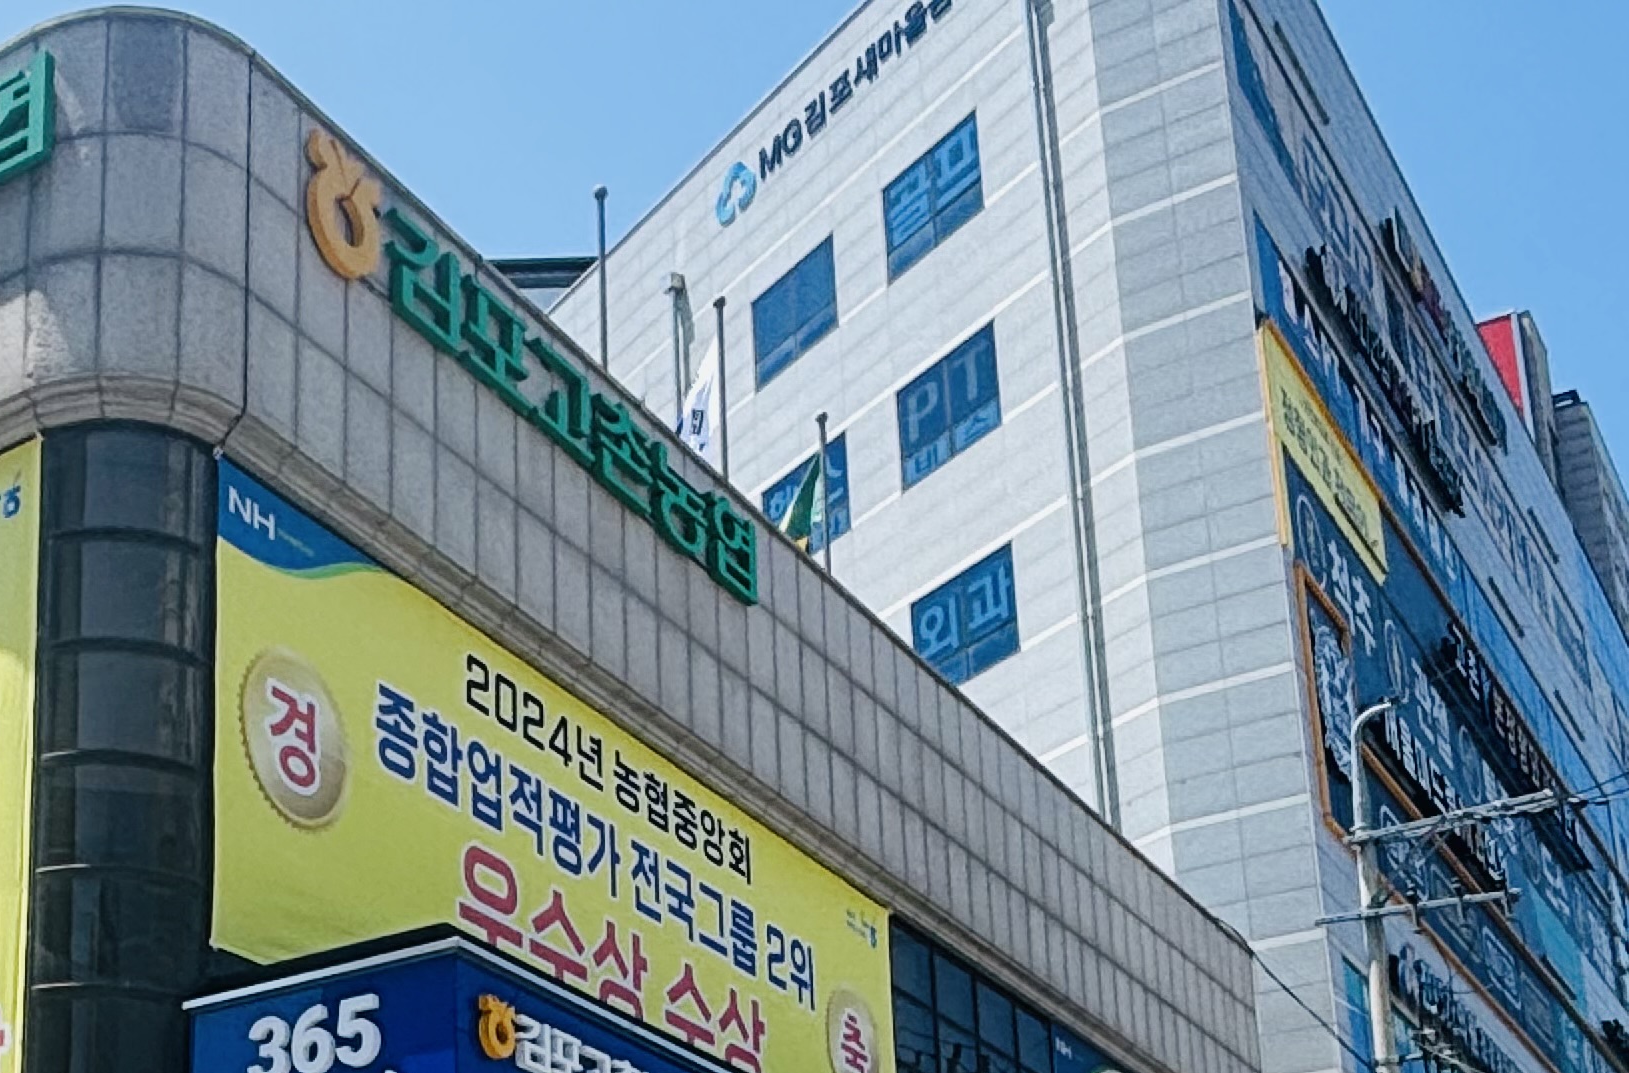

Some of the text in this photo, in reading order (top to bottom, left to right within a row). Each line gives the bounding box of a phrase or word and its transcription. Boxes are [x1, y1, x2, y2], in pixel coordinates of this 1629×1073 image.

[381, 207, 759, 606] 김포고촌농협
[907, 338, 991, 442] PT
[228, 486, 276, 540] NH
[920, 563, 1010, 658] 외과
[270, 684, 317, 788] 경
[466, 653, 752, 884] 2024년 농협중앙회
[376, 684, 815, 1010] 종합업적평가 전국그룹 2위
[459, 846, 647, 1021] 우수상
